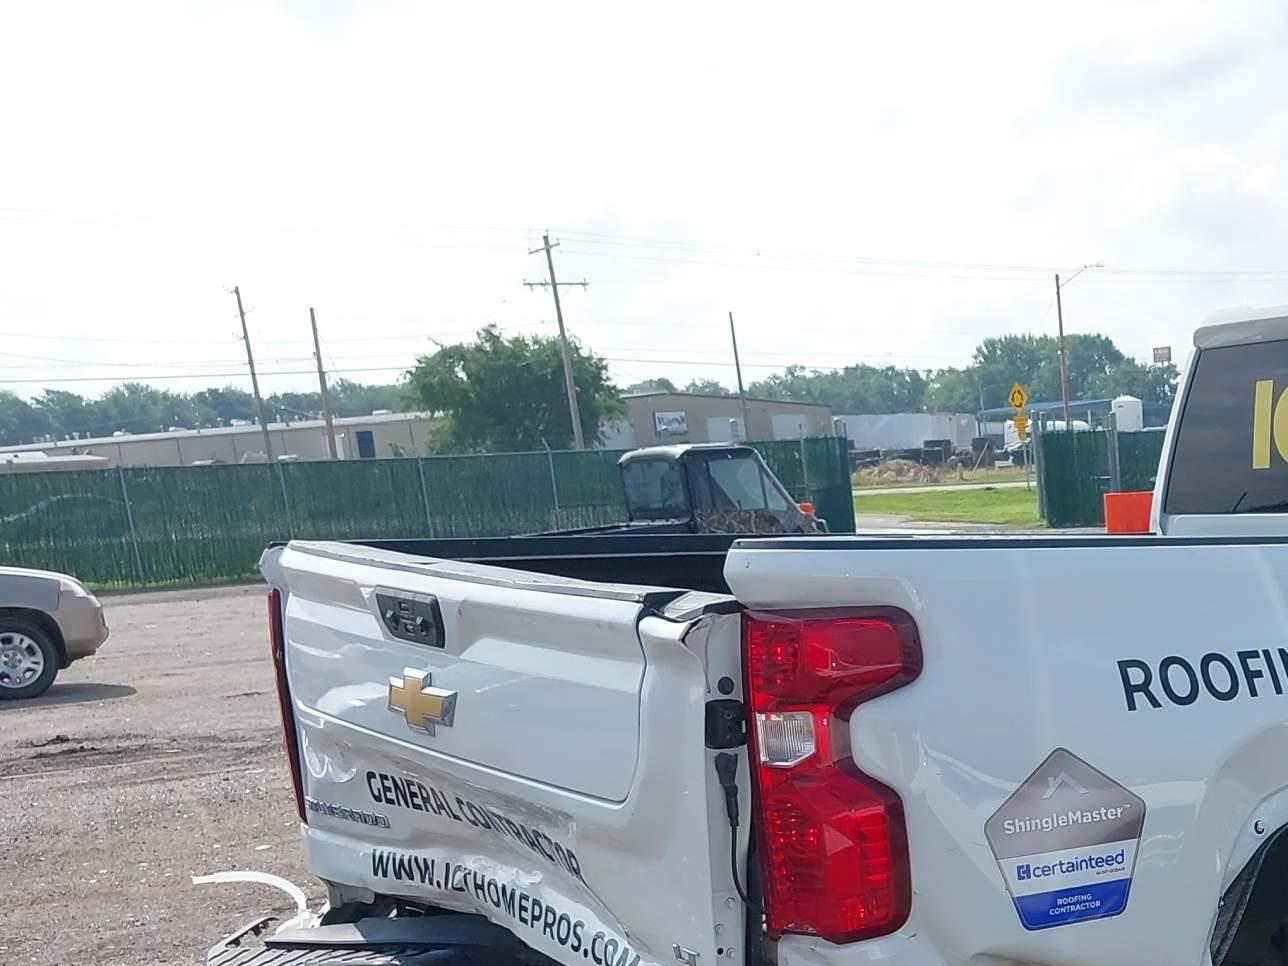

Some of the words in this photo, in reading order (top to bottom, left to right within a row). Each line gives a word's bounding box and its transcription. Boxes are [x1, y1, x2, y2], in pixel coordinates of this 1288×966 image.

[366, 770, 461, 822] GENERAL
[456, 797, 582, 879] CONTRACTOR
[1032, 849, 1126, 879] certainteed
[1049, 900, 1101, 916] CONTRACTOR
[1056, 893, 1093, 906] ROOFING
